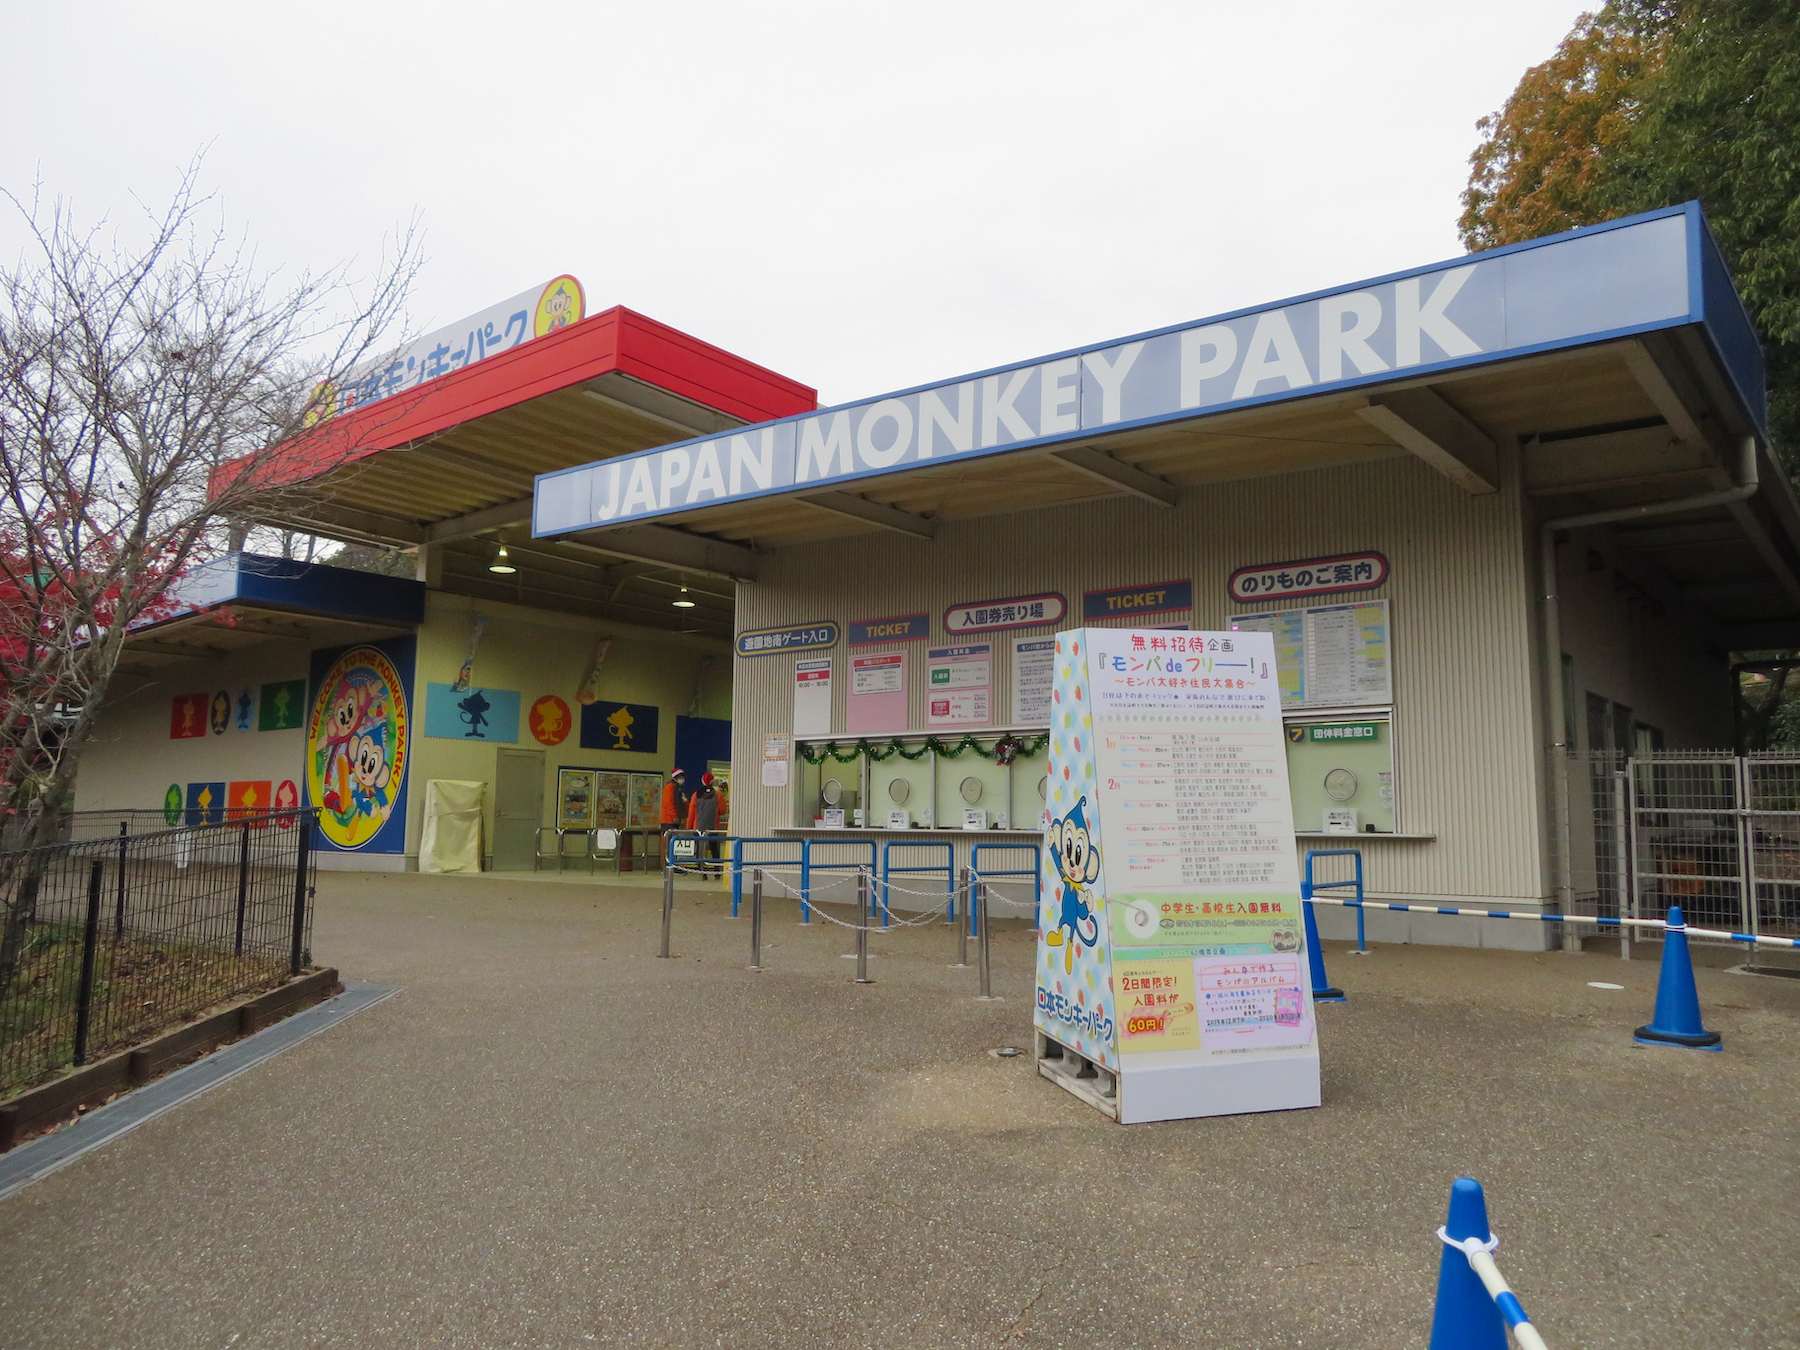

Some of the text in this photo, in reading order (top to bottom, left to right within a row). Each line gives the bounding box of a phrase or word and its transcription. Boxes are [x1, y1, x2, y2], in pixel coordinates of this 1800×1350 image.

[598, 263, 1483, 522] JAPAN MONKEY PARK
[1241, 561, 1373, 593] のりものご案内
[1106, 590, 1167, 610] TICKET
[962, 601, 1045, 626] 入園券売り場
[744, 628, 829, 651] 遊園地南ゲート入口
[866, 622, 910, 638] TICKET
[1131, 634, 1234, 654] 無料招待企画
[309, 651, 406, 789] WELCOME TO THE MONKEY PARK!
[1291, 728, 1304, 741] 7
[1313, 727, 1374, 739] 団体料金窓口
[1122, 976, 1178, 992] 2日間限定!
[1134, 993, 1180, 1007] 入園料が
[1036, 986, 1114, 1043] 日本モンキーパーク
[1127, 1017, 1165, 1034] 60円!
